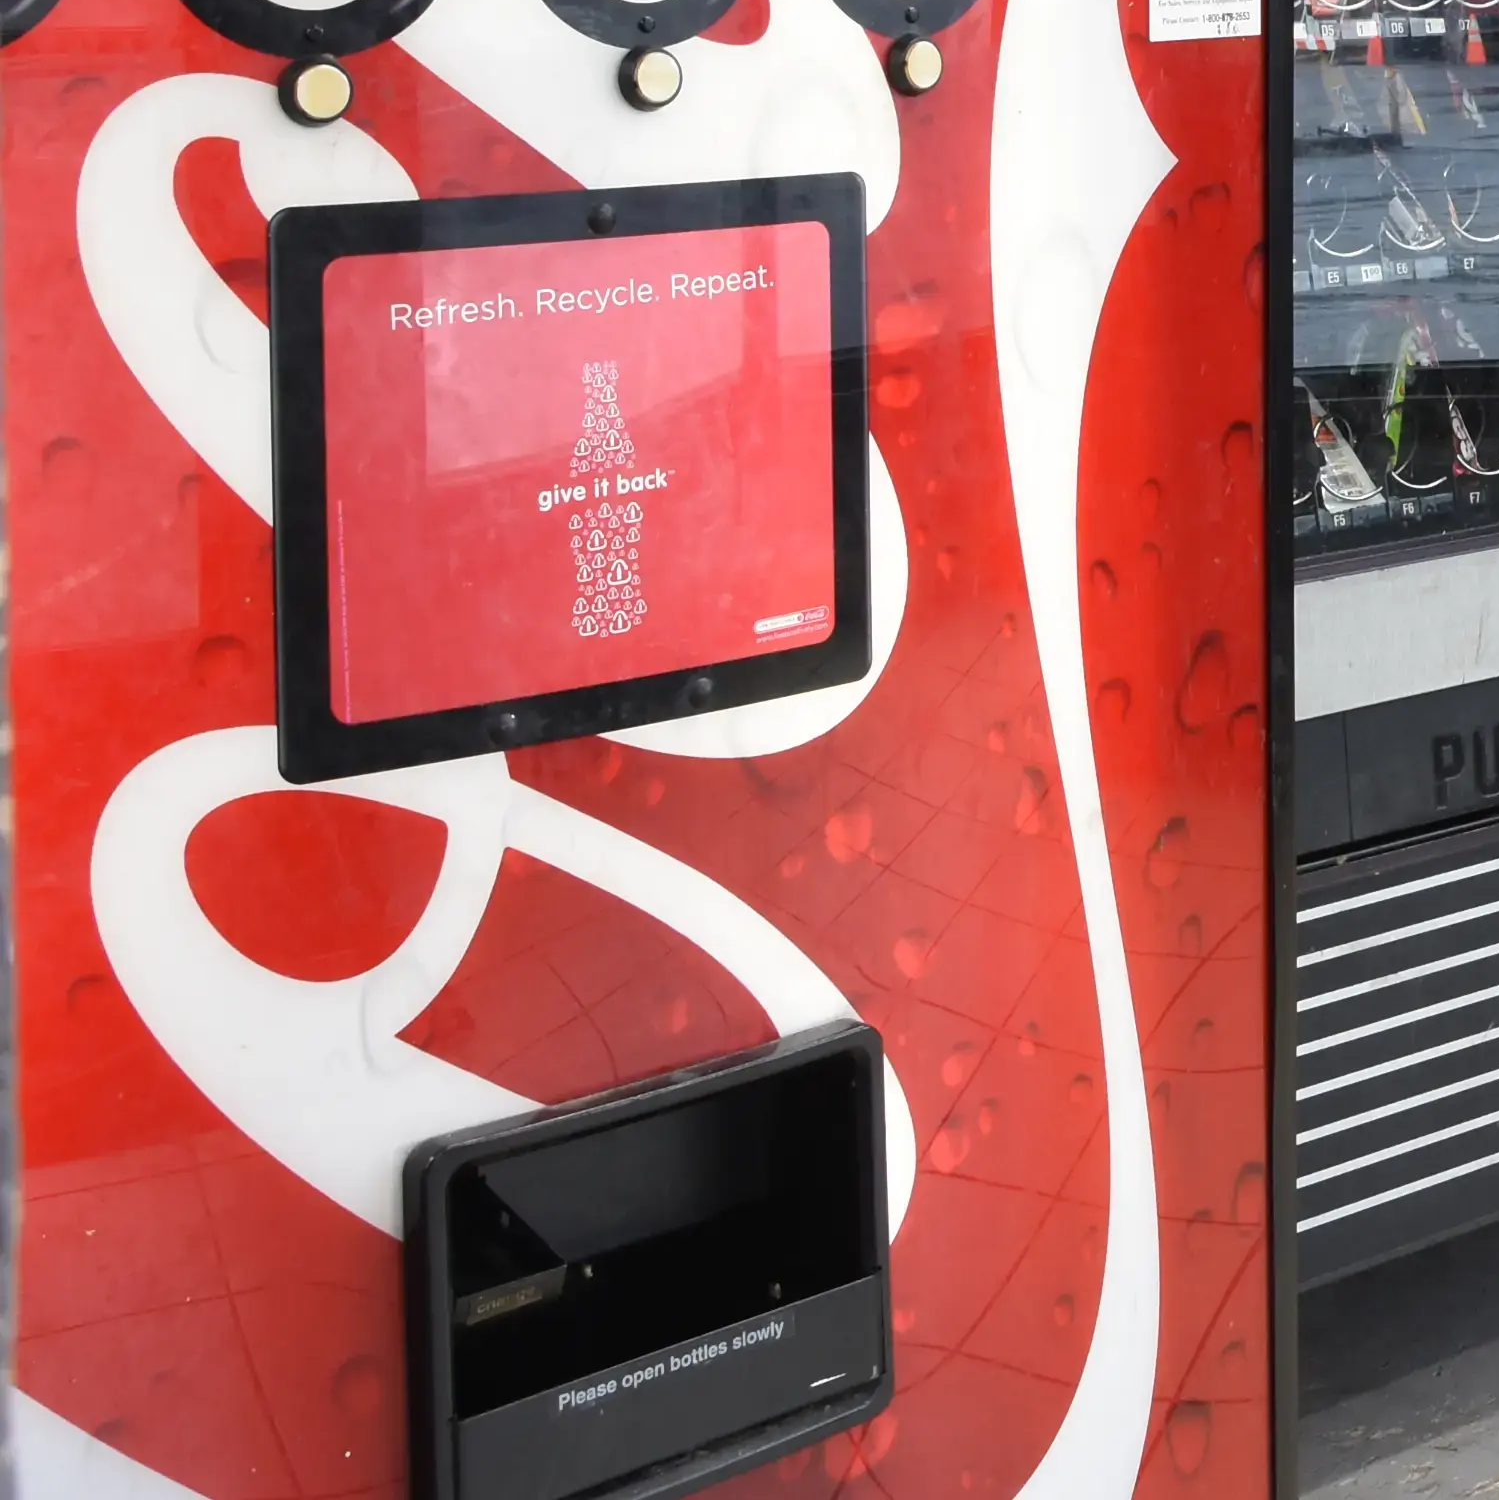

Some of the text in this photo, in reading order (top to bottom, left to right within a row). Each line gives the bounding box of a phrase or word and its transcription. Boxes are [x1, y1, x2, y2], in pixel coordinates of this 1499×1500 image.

[1321, 24, 1335, 37] D5
[1391, 22, 1404, 34] D6
[1396, 262, 1408, 274] E6
[1464, 257, 1475, 269] E7
[1328, 271, 1340, 284] E5
[390, 264, 774, 330] Refresh. Recycle. Repeat.
[537, 485, 586, 512] give
[594, 476, 610, 498] it
[1469, 492, 1480, 504] F7
[1402, 503, 1415, 515] F6
[1334, 514, 1346, 526] F5
[558, 1319, 785, 1411] Please open bottles slowly
